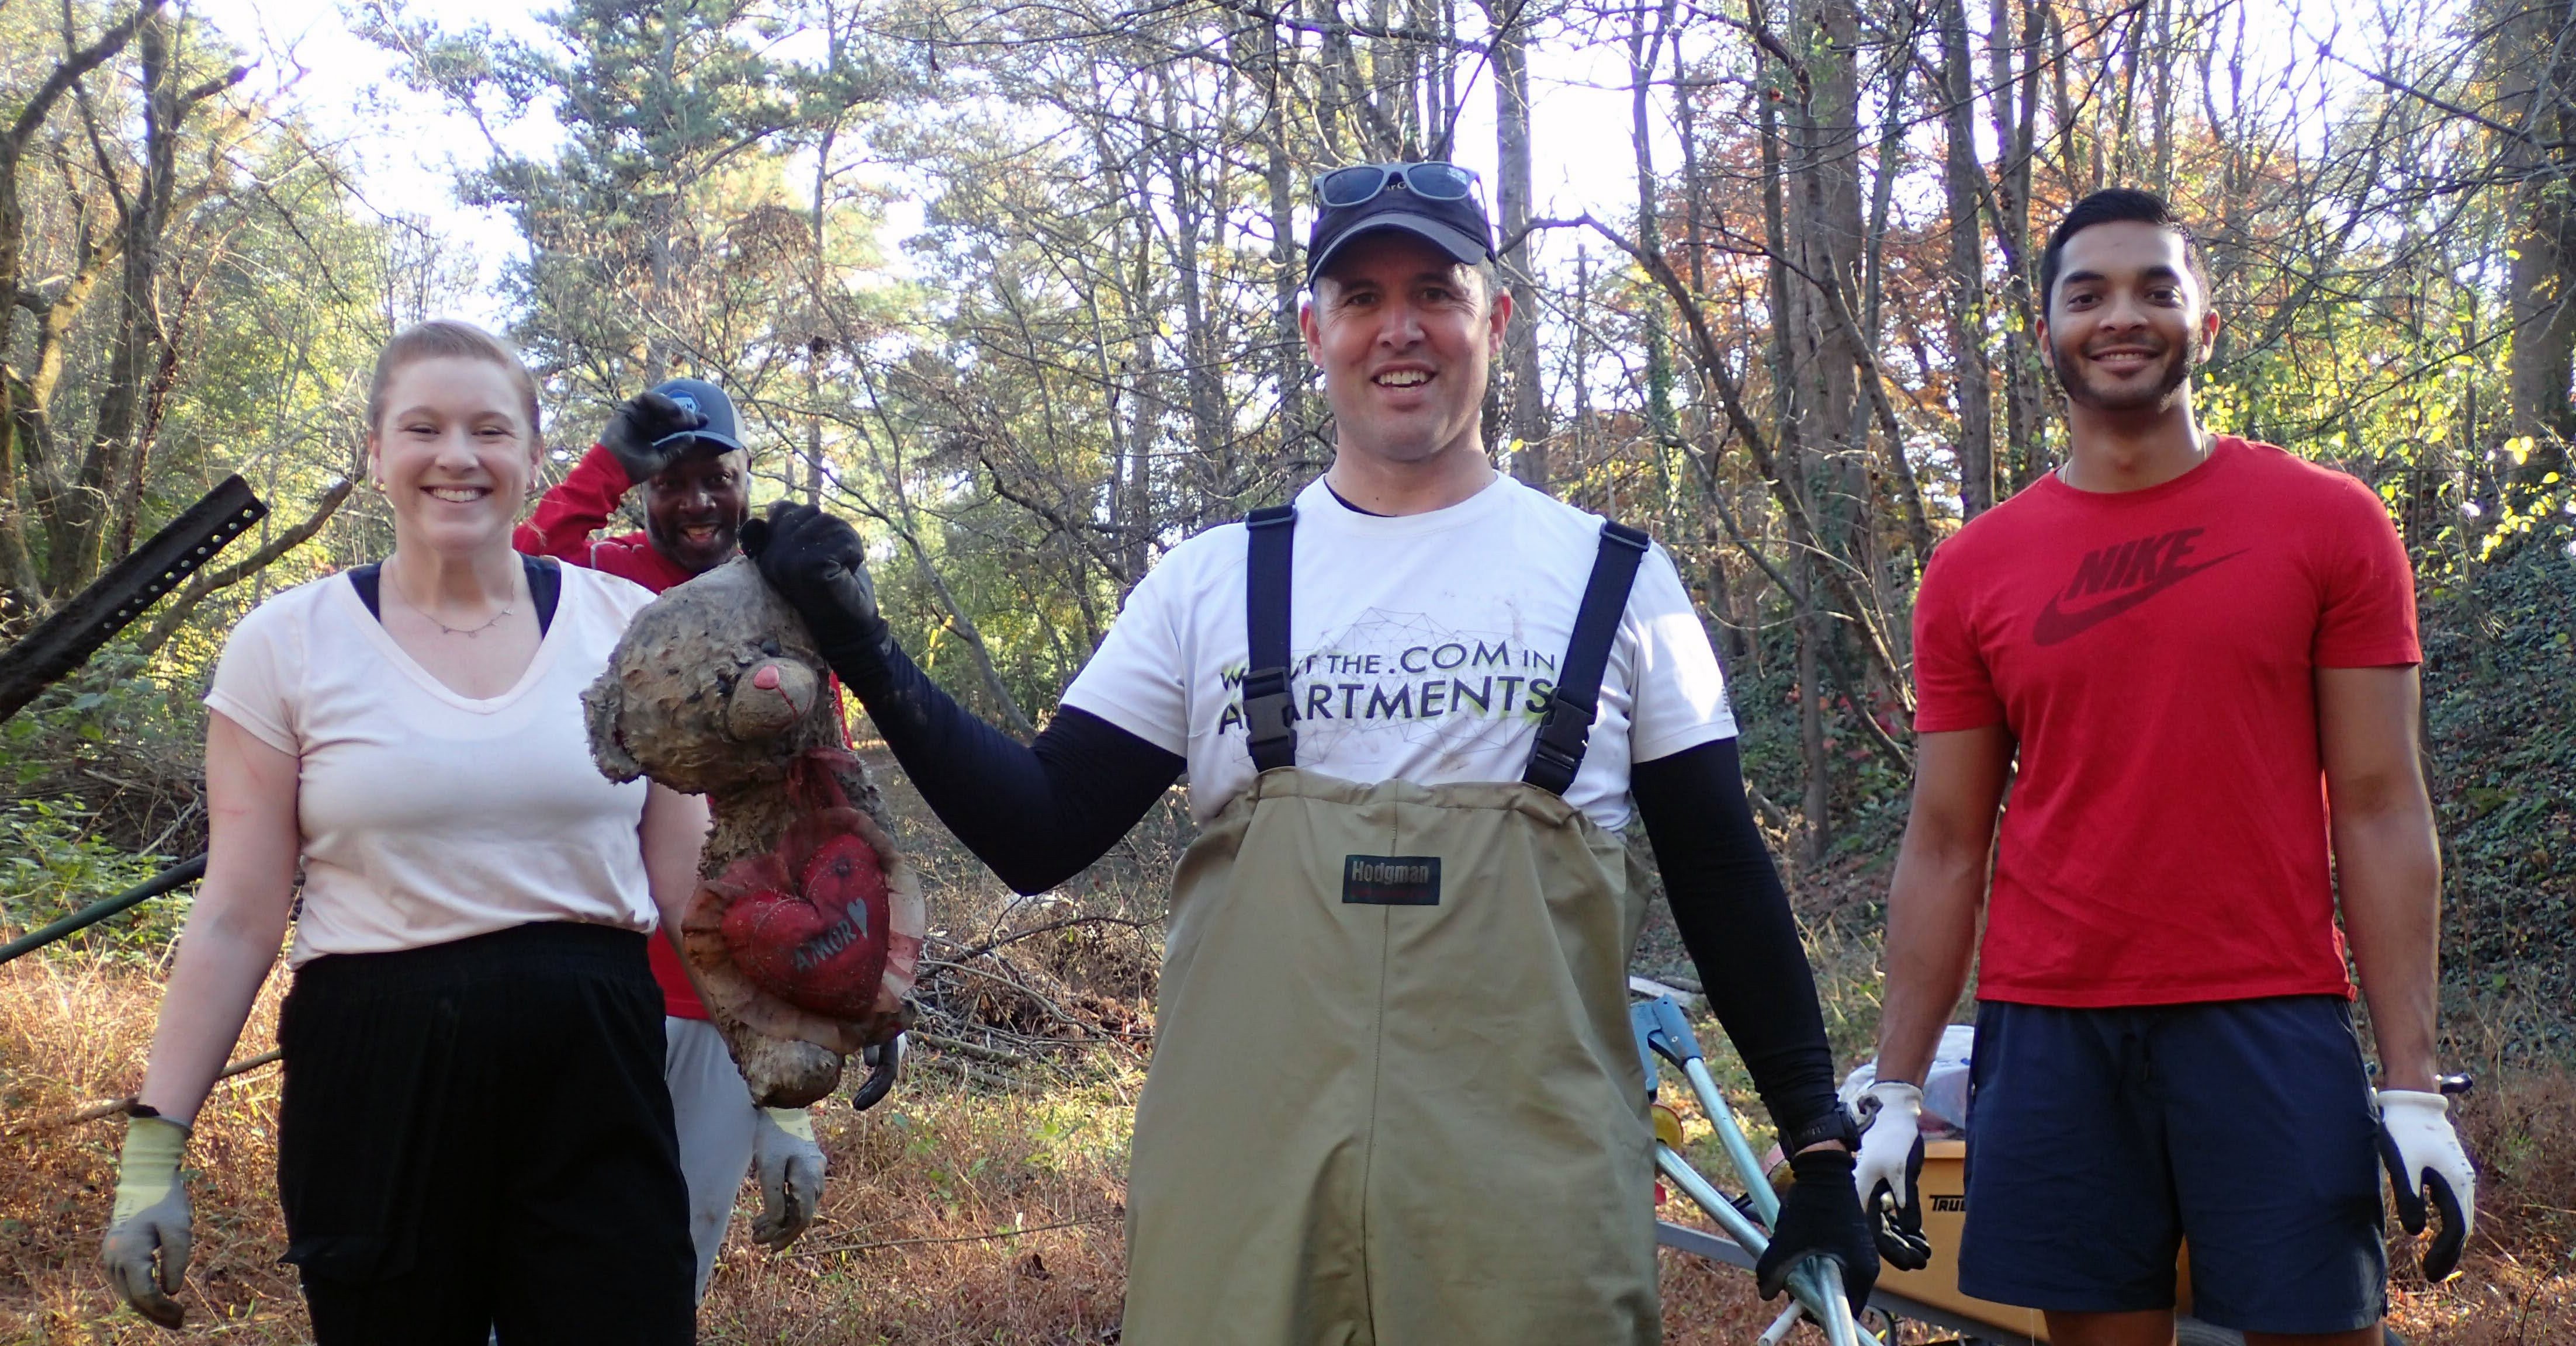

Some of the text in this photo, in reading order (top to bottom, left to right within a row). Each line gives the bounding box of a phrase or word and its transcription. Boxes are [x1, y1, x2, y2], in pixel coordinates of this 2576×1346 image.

[2063, 527, 2205, 602] NIKE
[1327, 654, 1380, 674] THE
[1389, 640, 1510, 674] .COM
[1524, 650, 1554, 671] IN
[1351, 861, 1429, 885] Hodgman
[794, 920, 857, 973] AMOR
